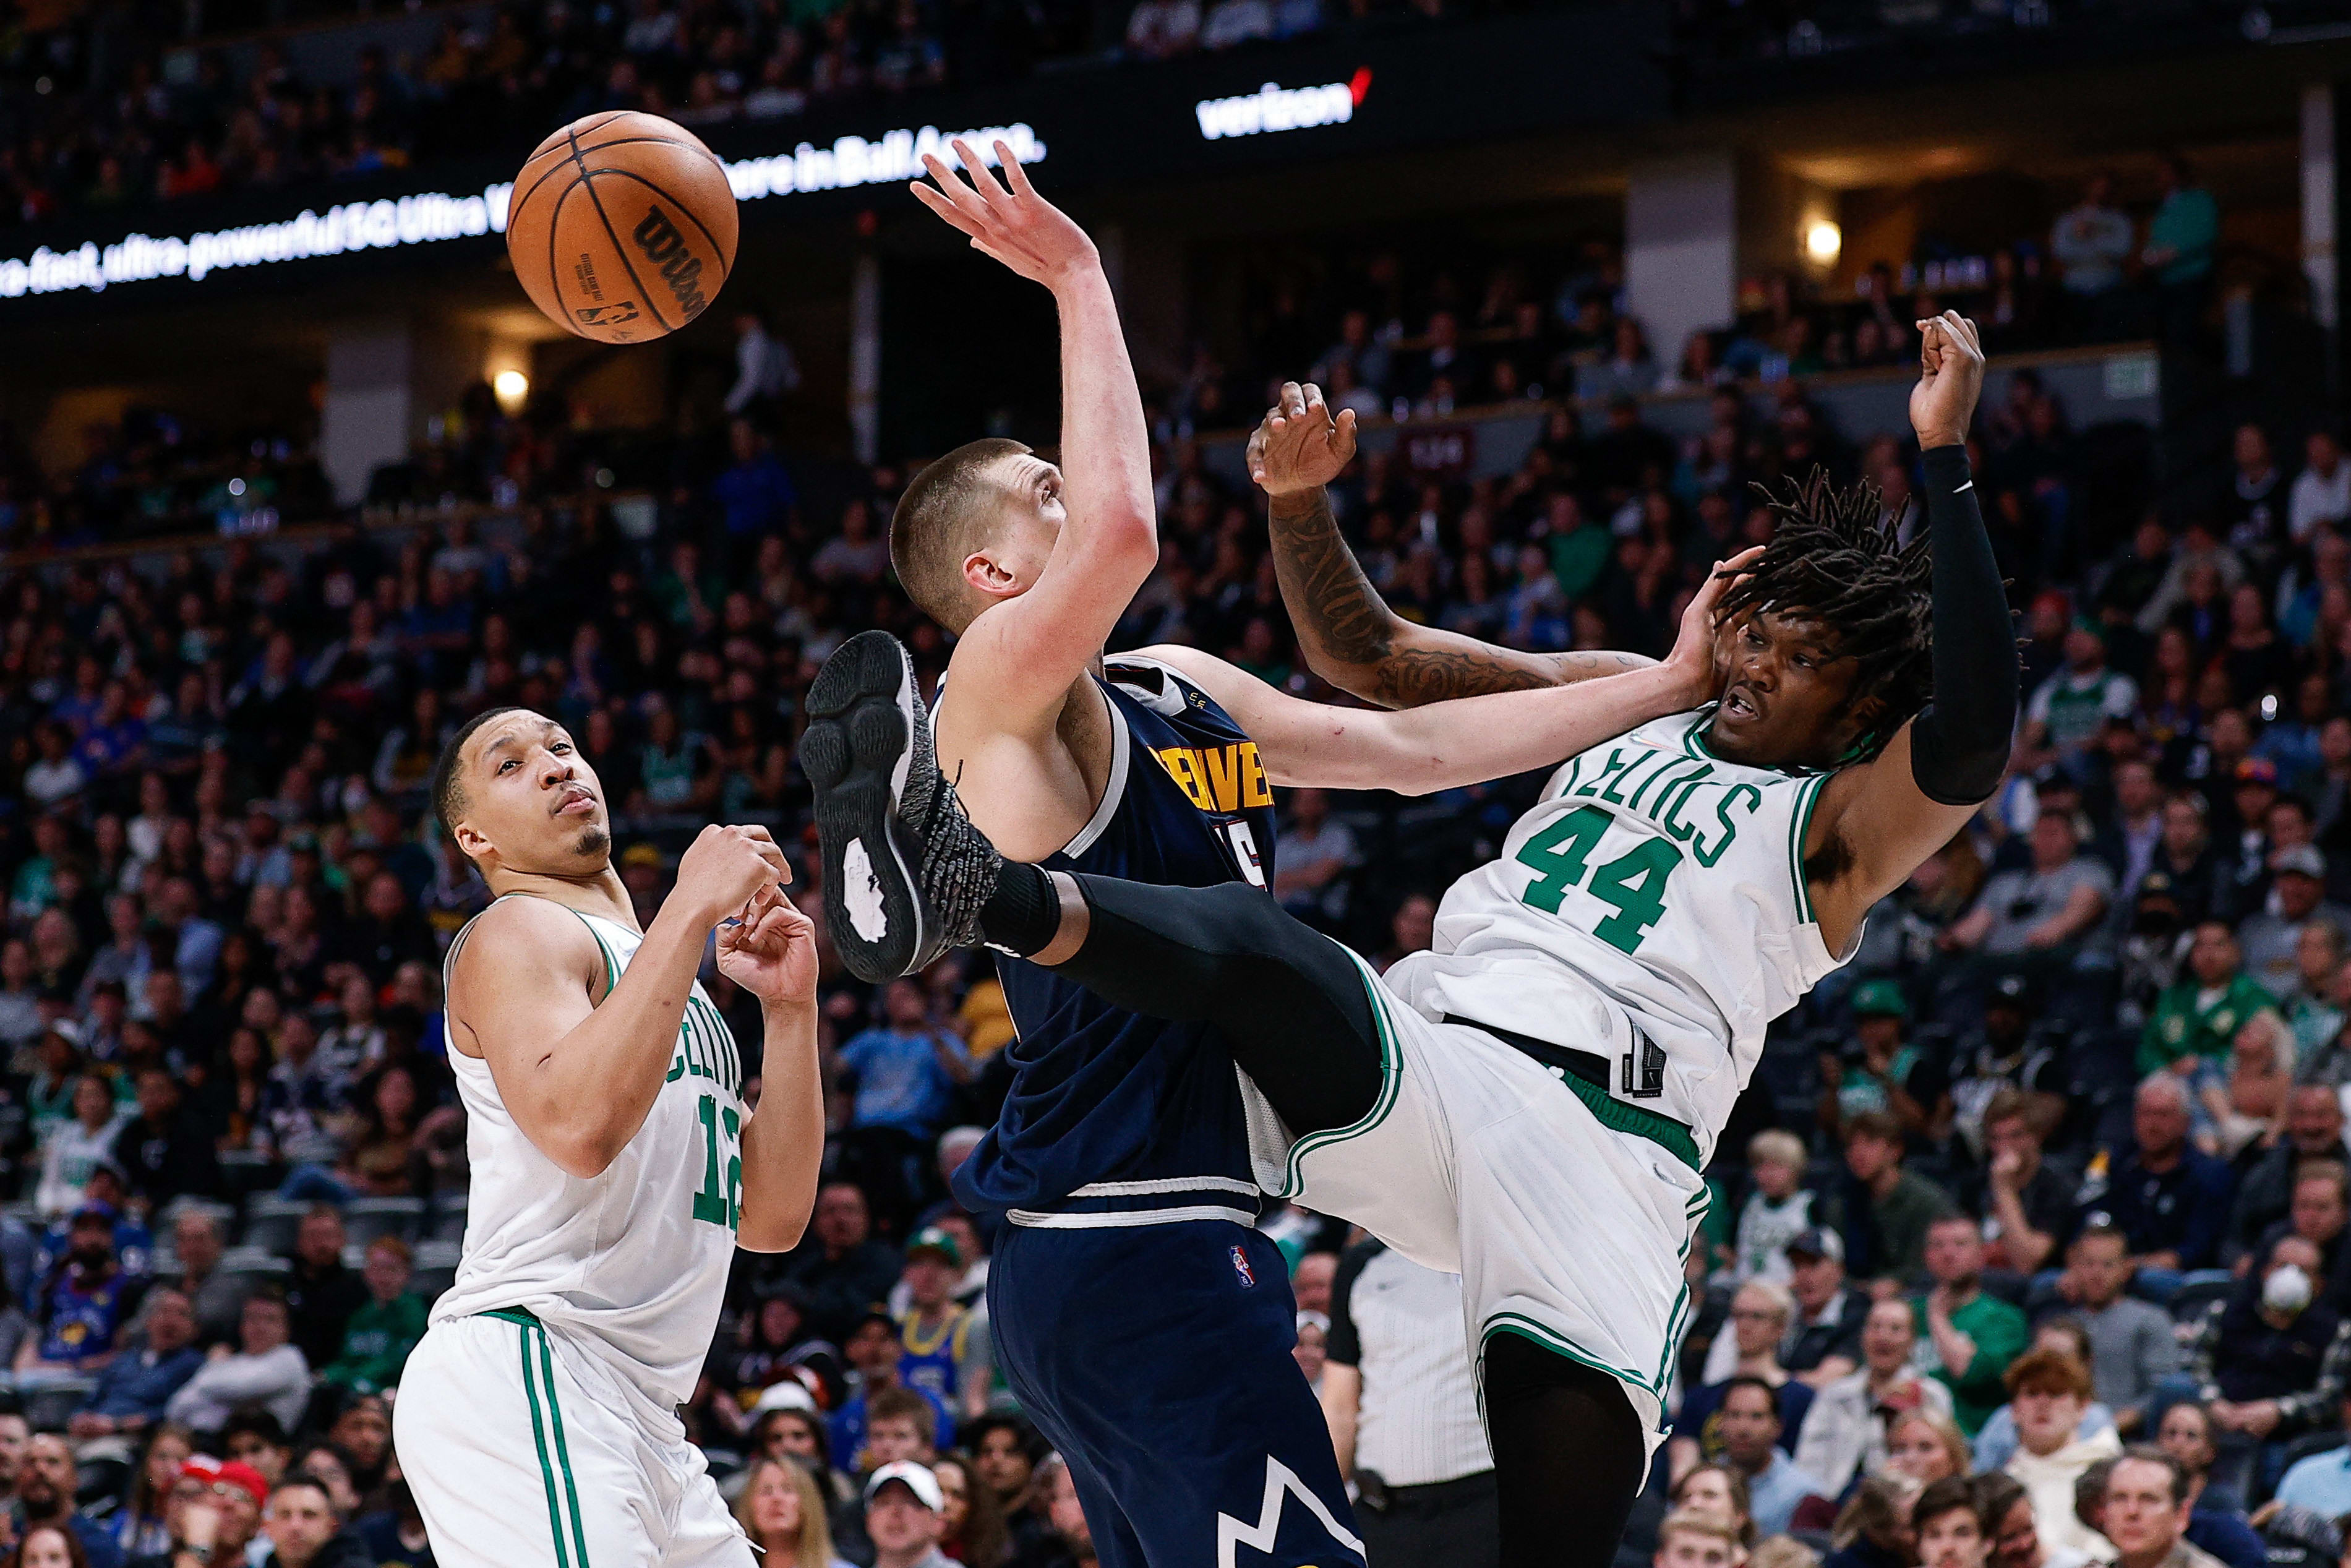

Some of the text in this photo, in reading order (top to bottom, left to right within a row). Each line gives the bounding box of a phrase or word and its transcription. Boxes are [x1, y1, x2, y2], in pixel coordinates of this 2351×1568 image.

[1196, 82, 1353, 140] verizon
[397, 191, 487, 242] Ultra
[720, 155, 794, 199] ere
[794, 142, 834, 192] in
[834, 131, 912, 187] Ball
[1515, 803, 1684, 956] 44
